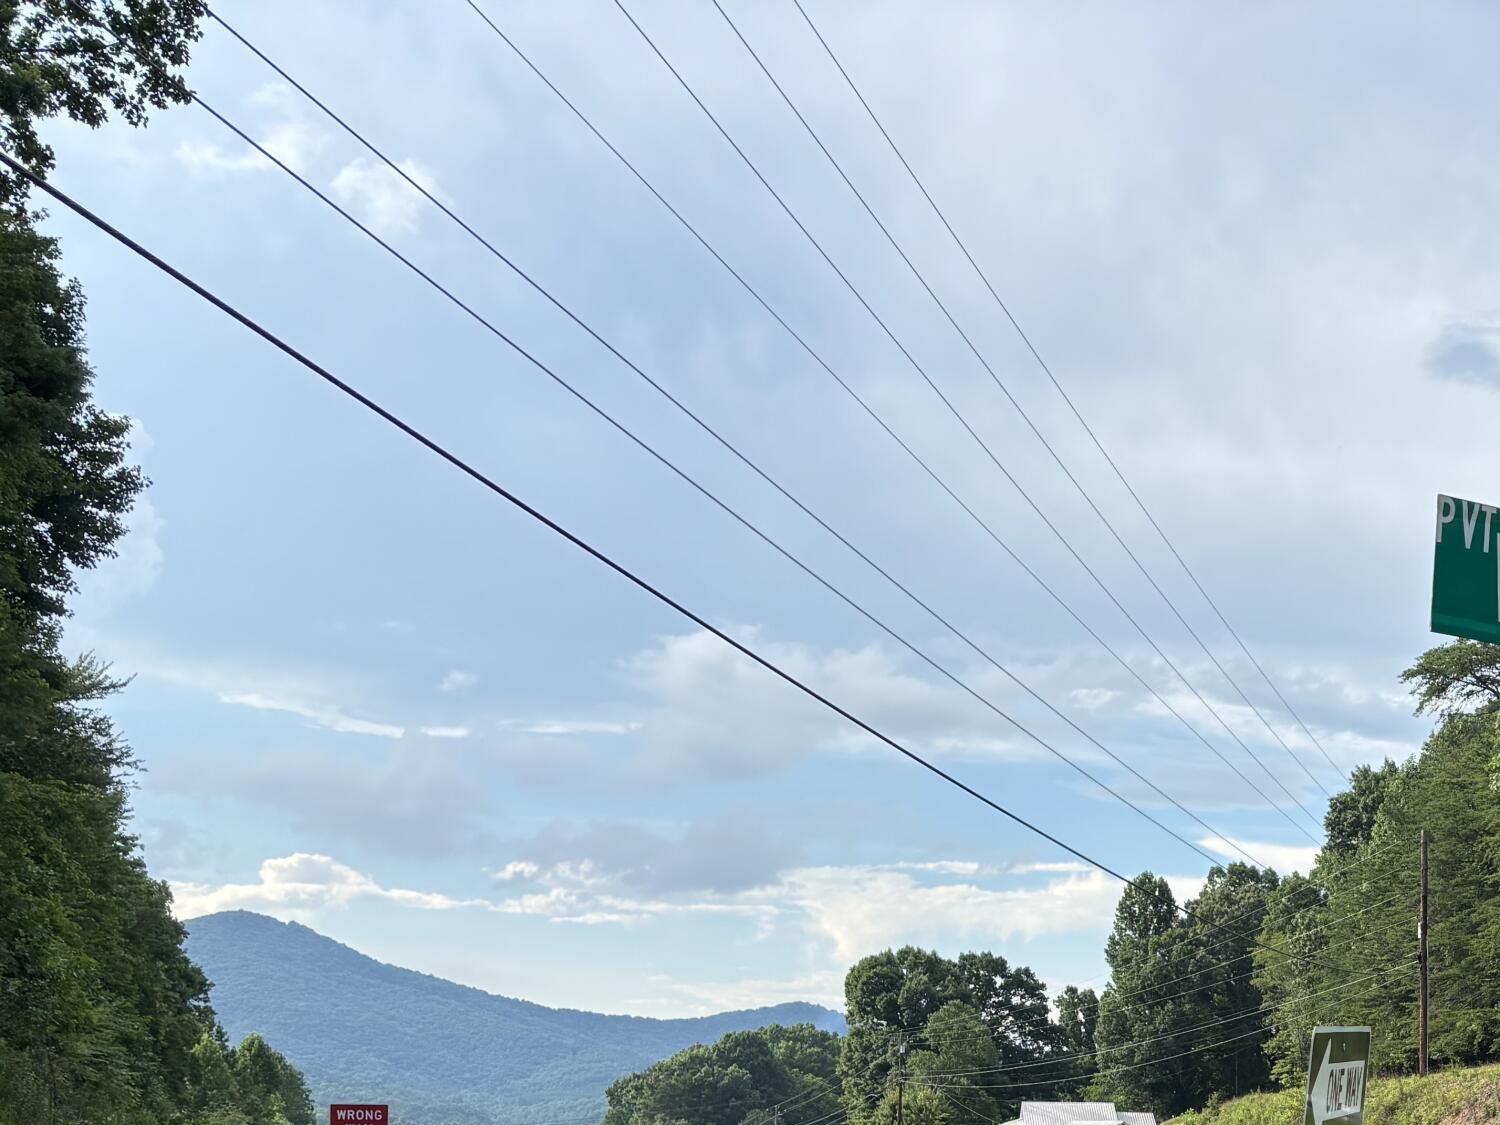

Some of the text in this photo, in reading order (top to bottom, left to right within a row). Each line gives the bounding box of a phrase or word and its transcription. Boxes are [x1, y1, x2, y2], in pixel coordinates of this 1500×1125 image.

[1436, 499, 1497, 553] PVT
[1326, 1065, 1363, 1113] ONE WAY
[336, 1109, 383, 1120] WRONG
